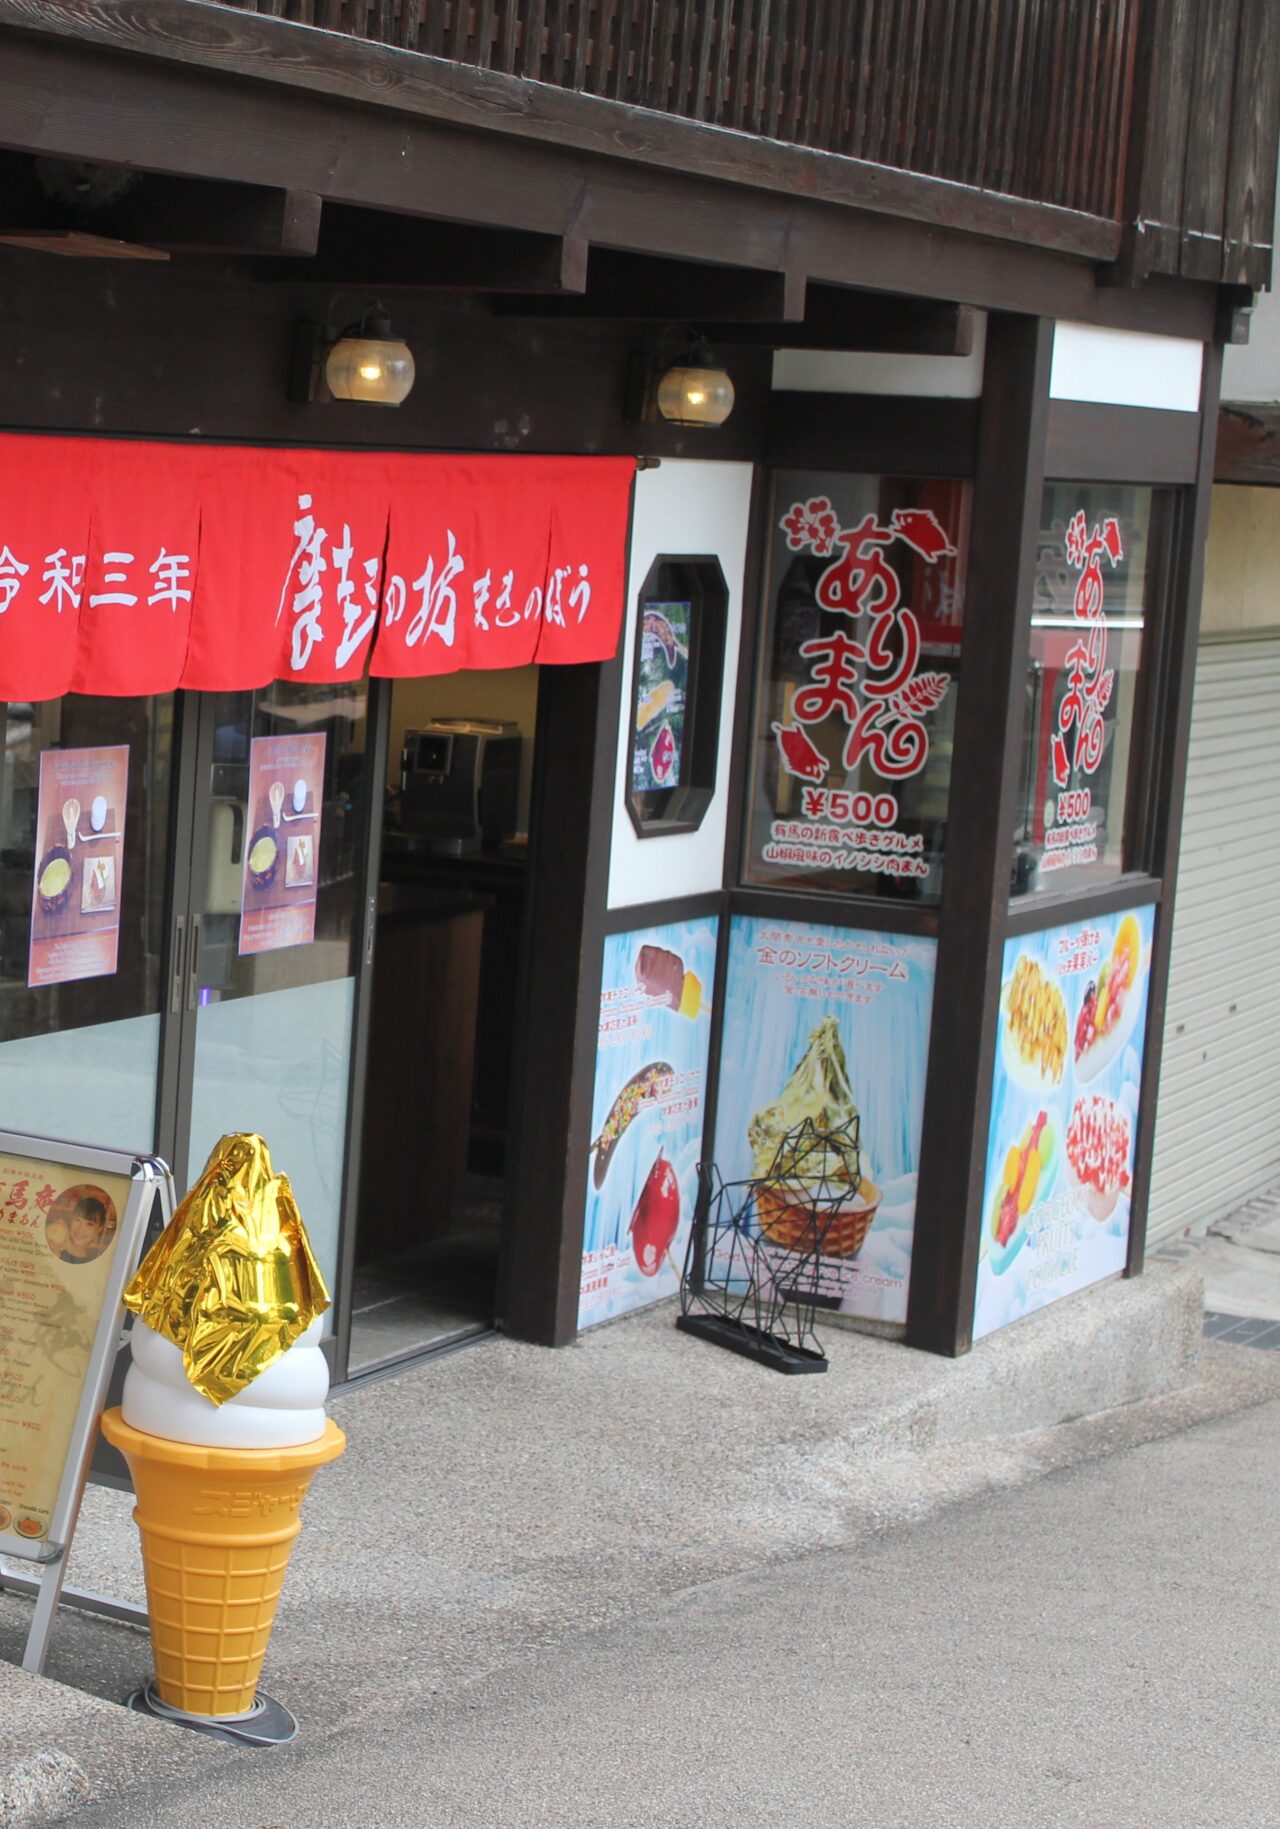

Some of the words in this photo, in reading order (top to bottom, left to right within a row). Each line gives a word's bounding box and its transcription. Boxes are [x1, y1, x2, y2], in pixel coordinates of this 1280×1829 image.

[804, 788, 896, 826] ¥500
[1058, 790, 1090, 819] ¥500
[773, 823, 923, 849] 有馬の新食べ歩きグルメ
[757, 946, 906, 979] 金のソフトクリーム
